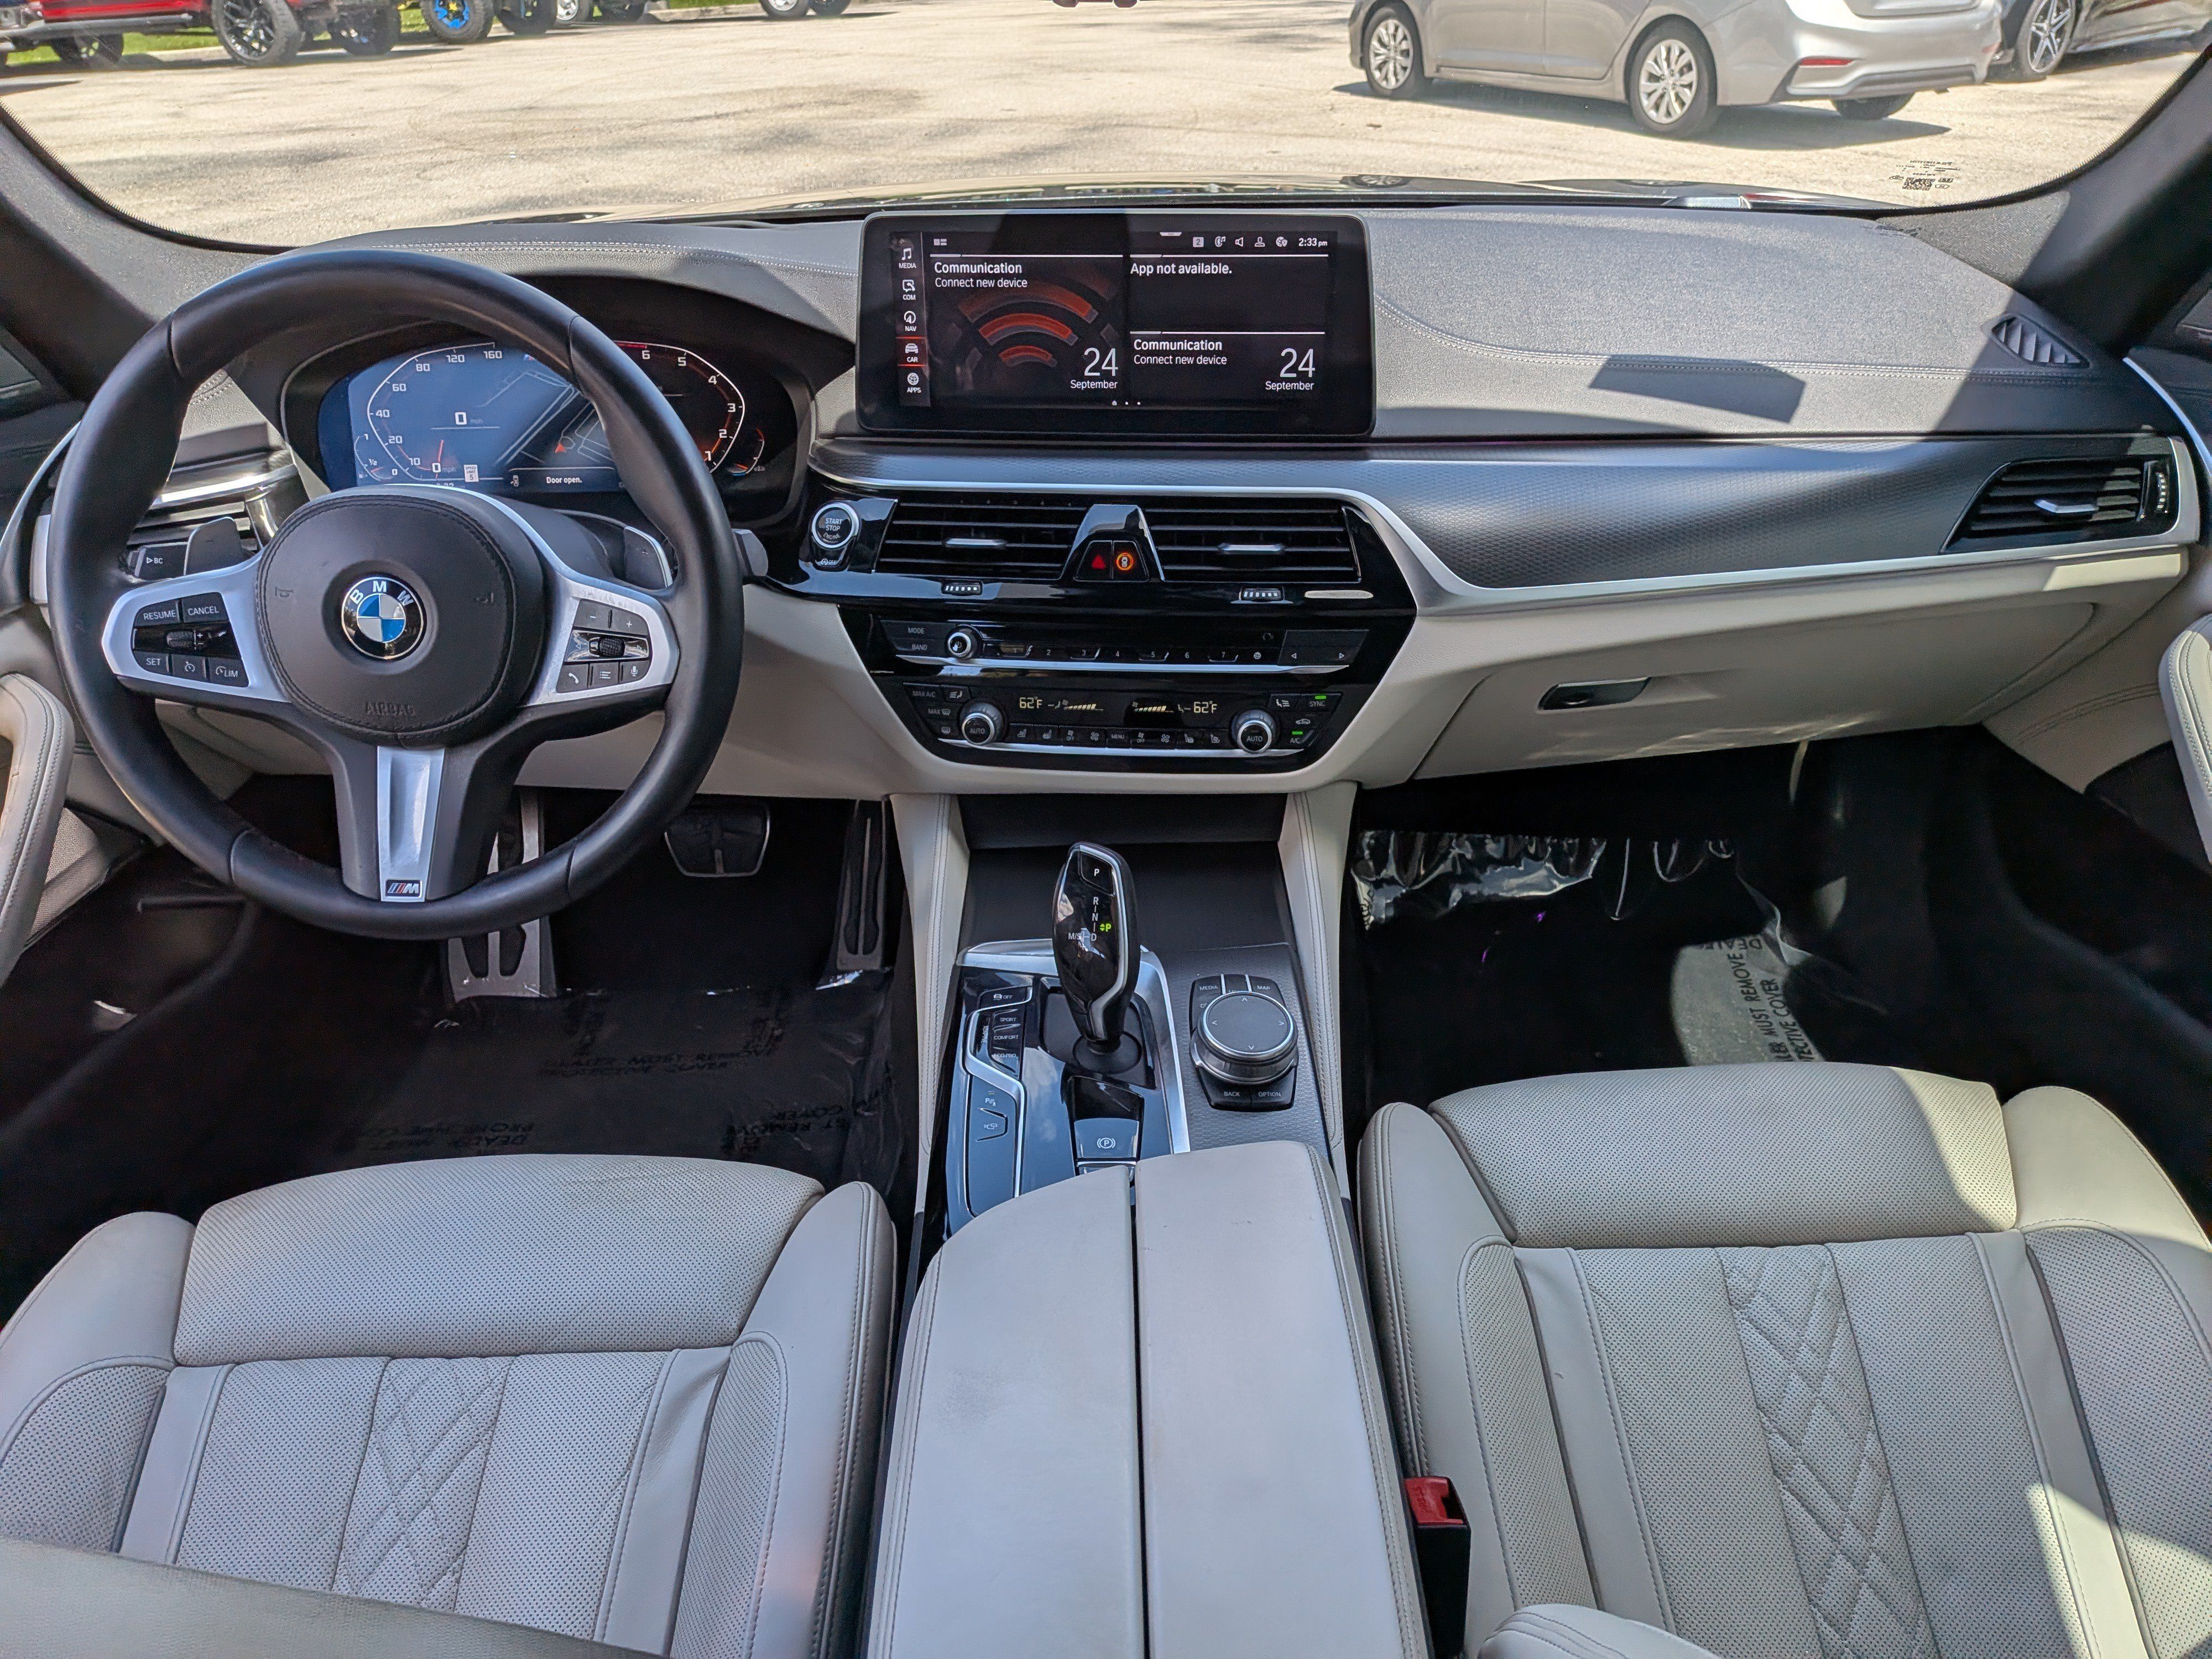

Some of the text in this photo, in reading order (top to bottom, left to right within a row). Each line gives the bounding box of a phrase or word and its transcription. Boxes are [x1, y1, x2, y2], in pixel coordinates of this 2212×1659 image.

[1298, 238, 1317, 247] 2:33
[935, 262, 1022, 274] Communication
[1130, 263, 1232, 275] App not available.
[935, 278, 1027, 288] Connect new device
[1134, 339, 1222, 351] Communication
[446, 354, 465, 363] 120
[483, 351, 502, 359] 160
[641, 351, 650, 359] 6
[1134, 354, 1173, 364] Connect
[1196, 354, 1227, 365] device
[677, 357, 686, 366] 5
[1083, 347, 1118, 377] 24
[1280, 348, 1315, 378] 24
[708, 375, 717, 384] 4
[392, 383, 406, 392] 60
[1070, 379, 1118, 390] September
[1265, 380, 1314, 391] September
[727, 404, 736, 413] 3
[375, 409, 390, 418] 40
[455, 412, 467, 425] 0
[719, 430, 727, 439] 2
[389, 435, 403, 444] 20
[705, 451, 711, 461] 1
[409, 457, 420, 466] 10
[432, 463, 441, 473] 0
[564, 477, 582, 485] open.
[349, 581, 414, 606] BMW
[143, 610, 176, 620] RESUME
[188, 606, 219, 615] CANCEL
[146, 658, 161, 666] SET
[224, 670, 238, 678] LIM
[364, 701, 415, 717] AIRBAG
[1093, 896, 1099, 905] R
[1092, 913, 1098, 921] N
[1105, 923, 1112, 932] P
[1091, 933, 1097, 941] D
[1728, 953, 1761, 1002] REMOVE
[1760, 978, 1792, 1018] COVER
[1750, 1007, 1779, 1037] MUST
